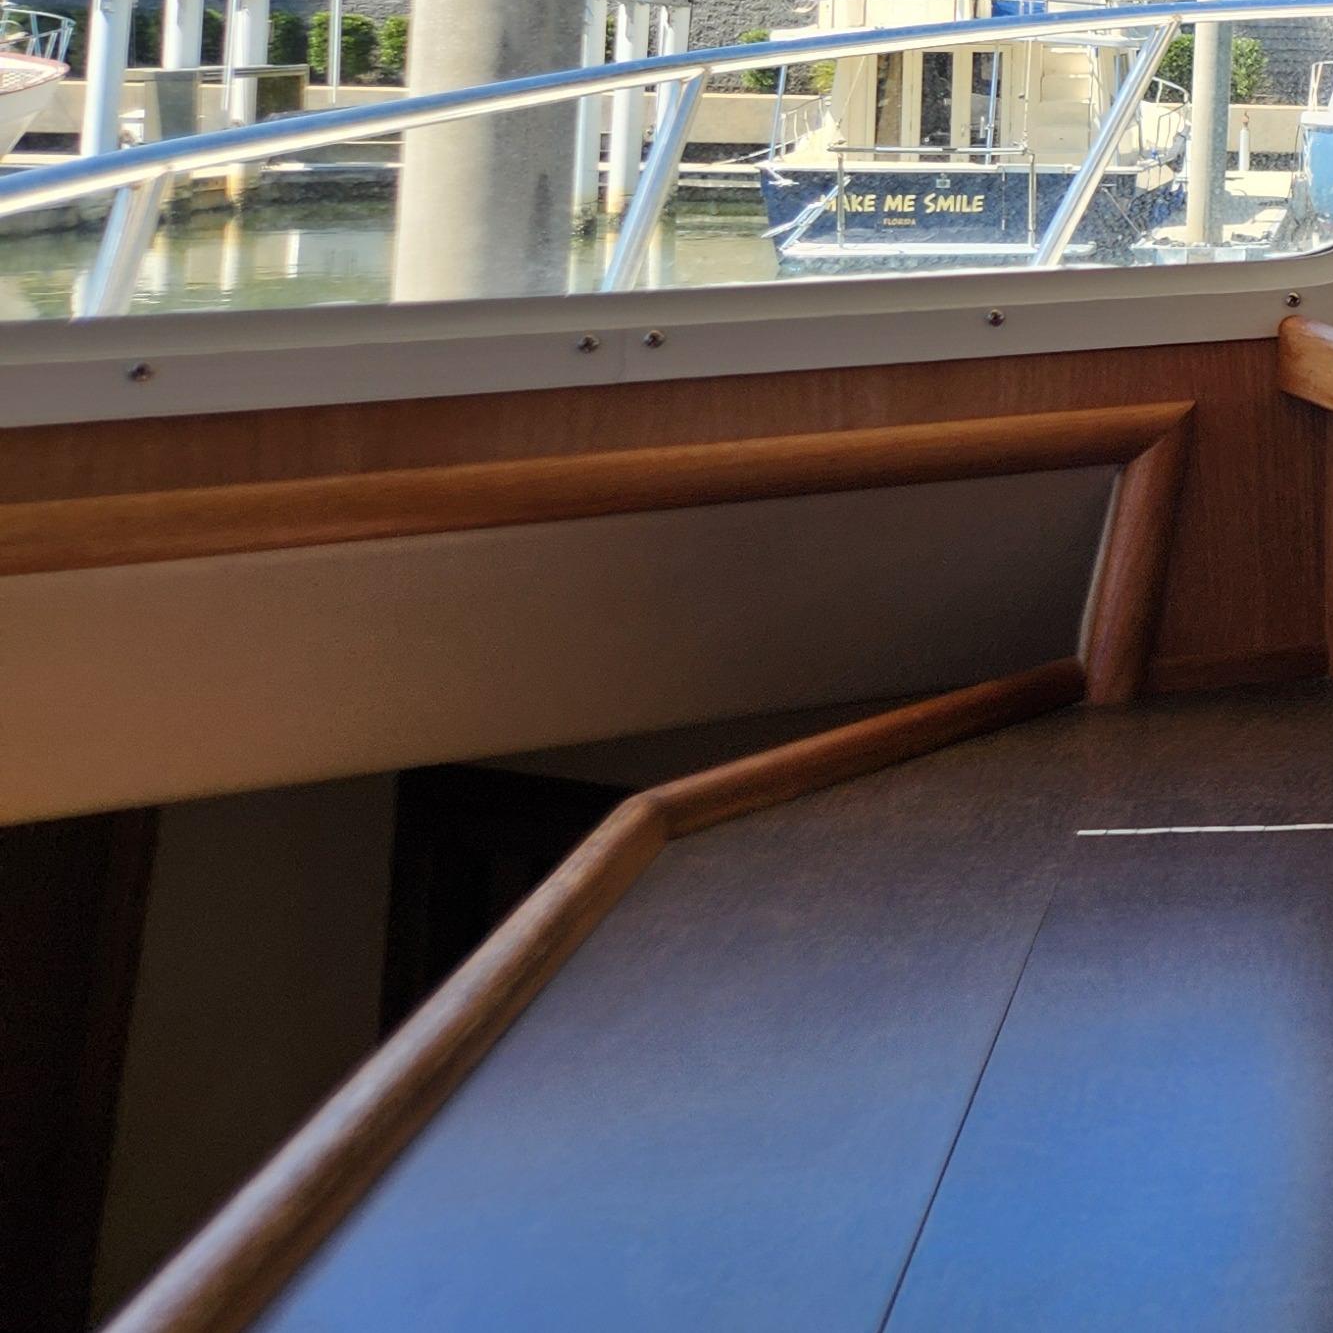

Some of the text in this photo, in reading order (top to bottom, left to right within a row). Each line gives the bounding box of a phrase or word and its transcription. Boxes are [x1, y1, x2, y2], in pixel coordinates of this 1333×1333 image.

[819, 193, 985, 214] MAKE ME SMILE
[882, 218, 916, 226] FLORIDA
